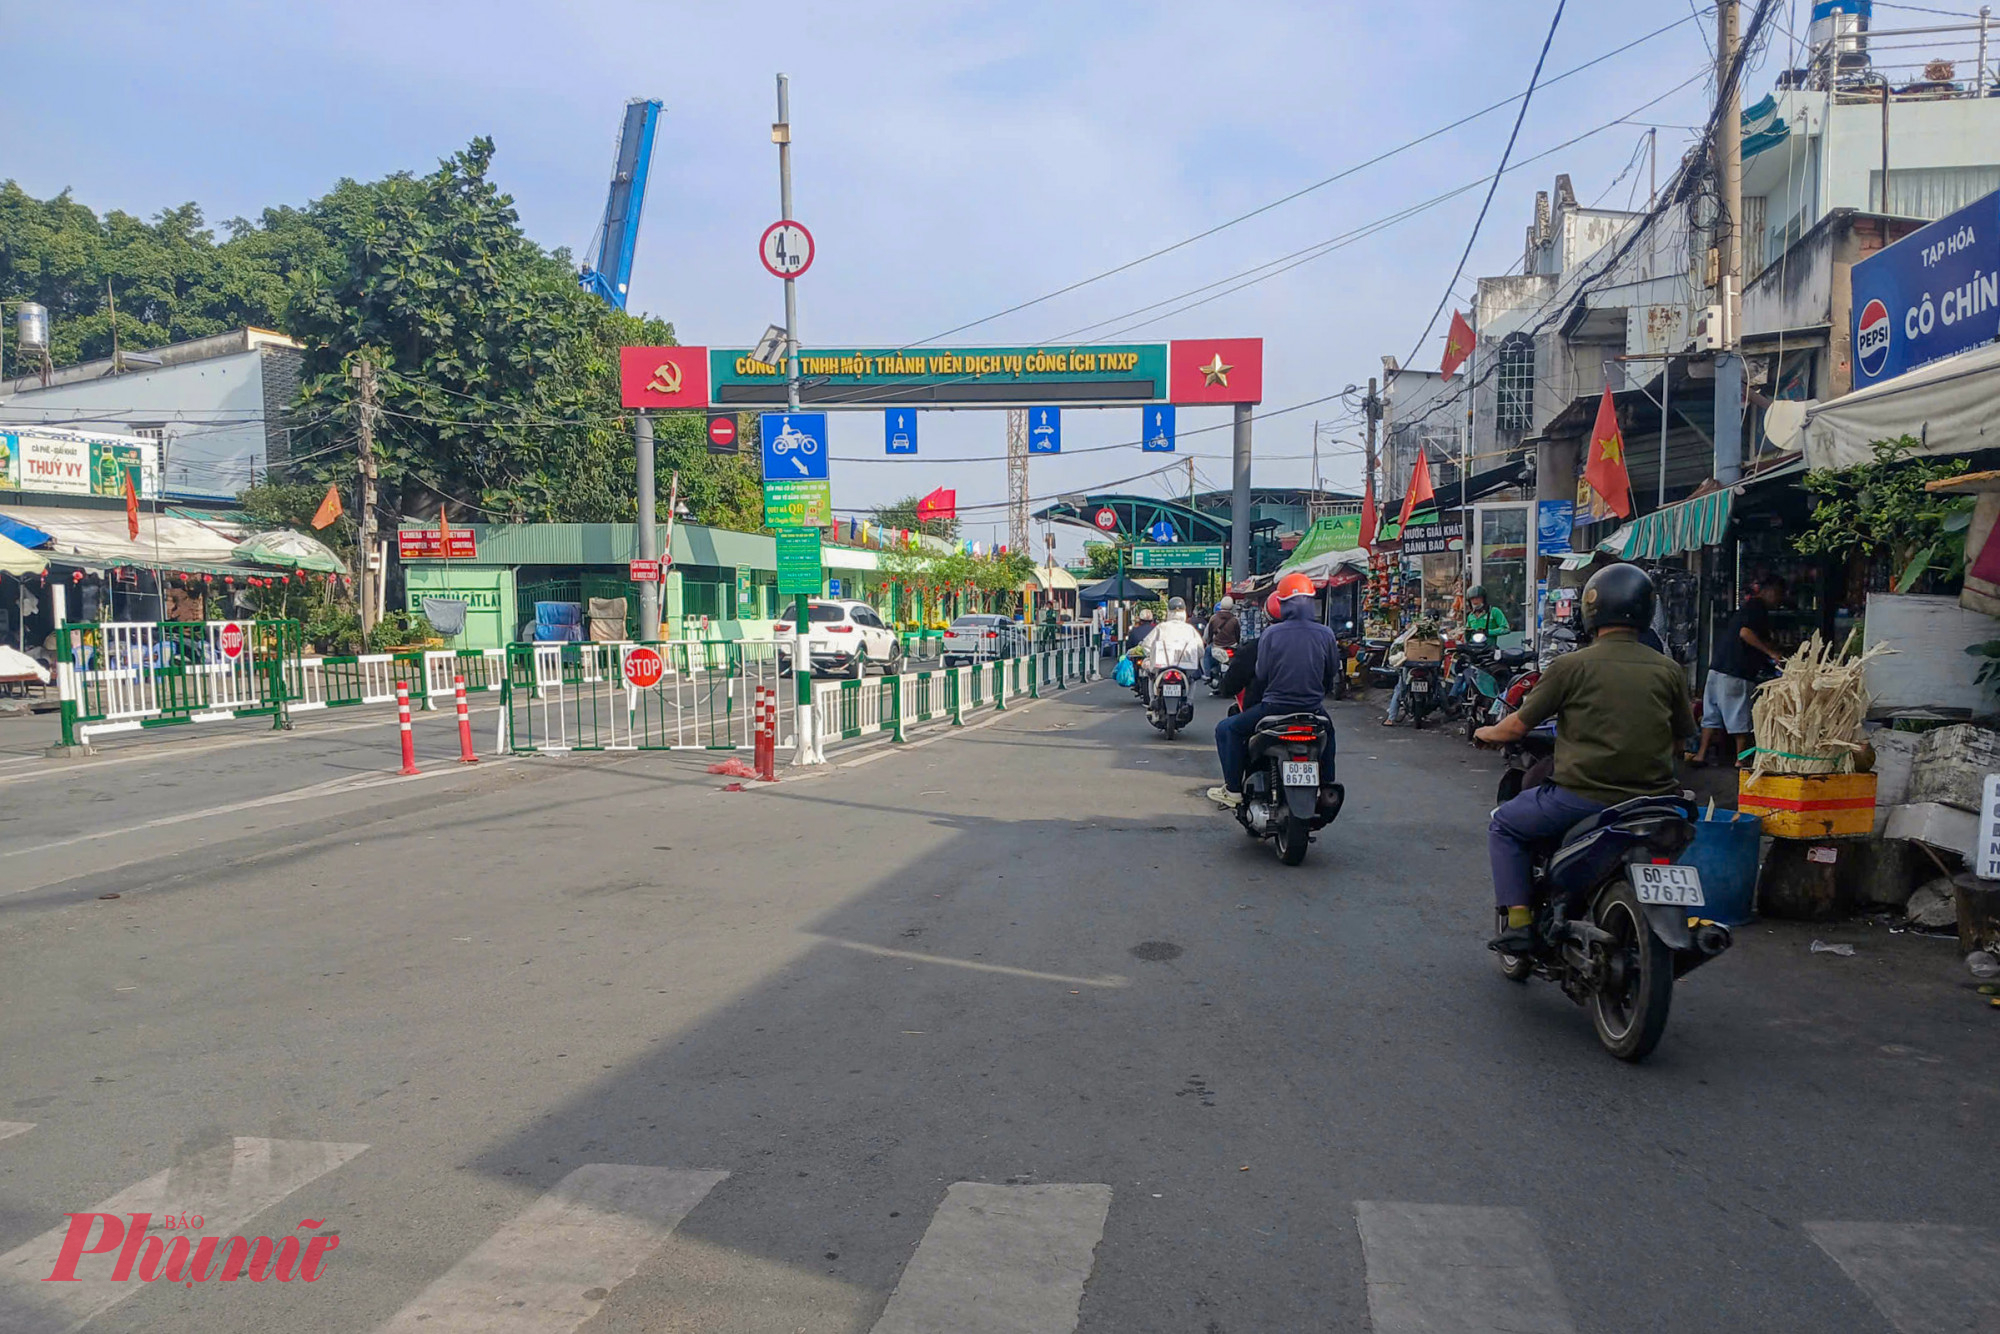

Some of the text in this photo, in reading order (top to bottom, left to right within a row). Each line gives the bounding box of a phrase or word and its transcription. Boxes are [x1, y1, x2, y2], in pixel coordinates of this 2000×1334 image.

[1921, 226, 1976, 268] TẠP HÓA
[1905, 292, 1936, 340] CÔ
[1859, 326, 1889, 351] PEPSI
[736, 352, 776, 374] CÔNG
[800, 357, 839, 374] TNHH
[840, 352, 873, 379] MỘT
[875, 352, 926, 374] THÀNH
[929, 352, 962, 374] VIÊN
[965, 355, 1001, 378] DỊCH
[1003, 355, 1022, 378] VỤ
[1025, 350, 1067, 373] CÔNG
[1069, 349, 1095, 372] ÍCH
[1098, 353, 1139, 371] TNXP
[65, 462, 82, 477] VY
[788, 503, 803, 515] QR
[1316, 519, 1344, 531] TEA
[222, 632, 241, 649] STOP
[626, 658, 660, 677] STOP
[1643, 867, 1688, 885] 60-C1
[1640, 884, 1699, 903] 376.73
